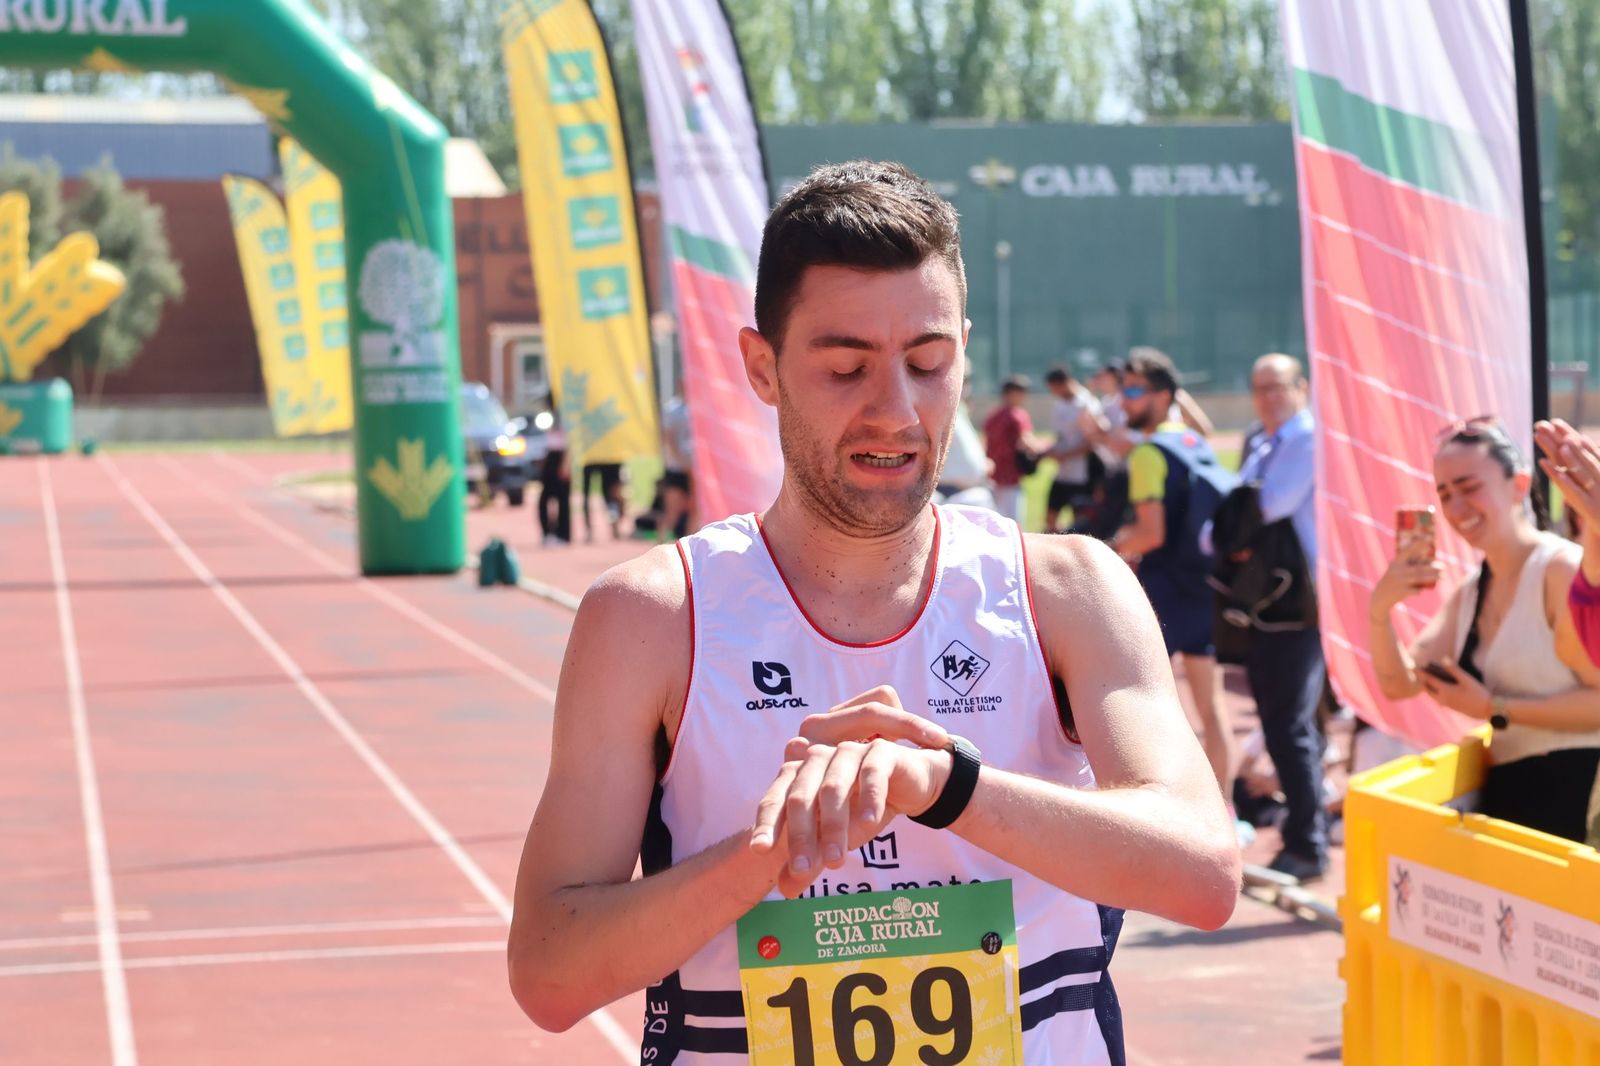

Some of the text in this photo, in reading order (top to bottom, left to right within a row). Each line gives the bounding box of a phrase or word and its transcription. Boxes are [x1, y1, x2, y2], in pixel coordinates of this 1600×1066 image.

[0, 0, 187, 36] RURAL
[1020, 164, 1118, 198] CAJA
[928, 696, 1002, 707] CLUB ATLETISMO
[977, 704, 996, 712] ULLA
[815, 920, 942, 945] CAJA RURAL
[817, 943, 887, 958] DE ZAMORA
[649, 1000, 668, 1034] DE
[767, 966, 973, 1066] 169
